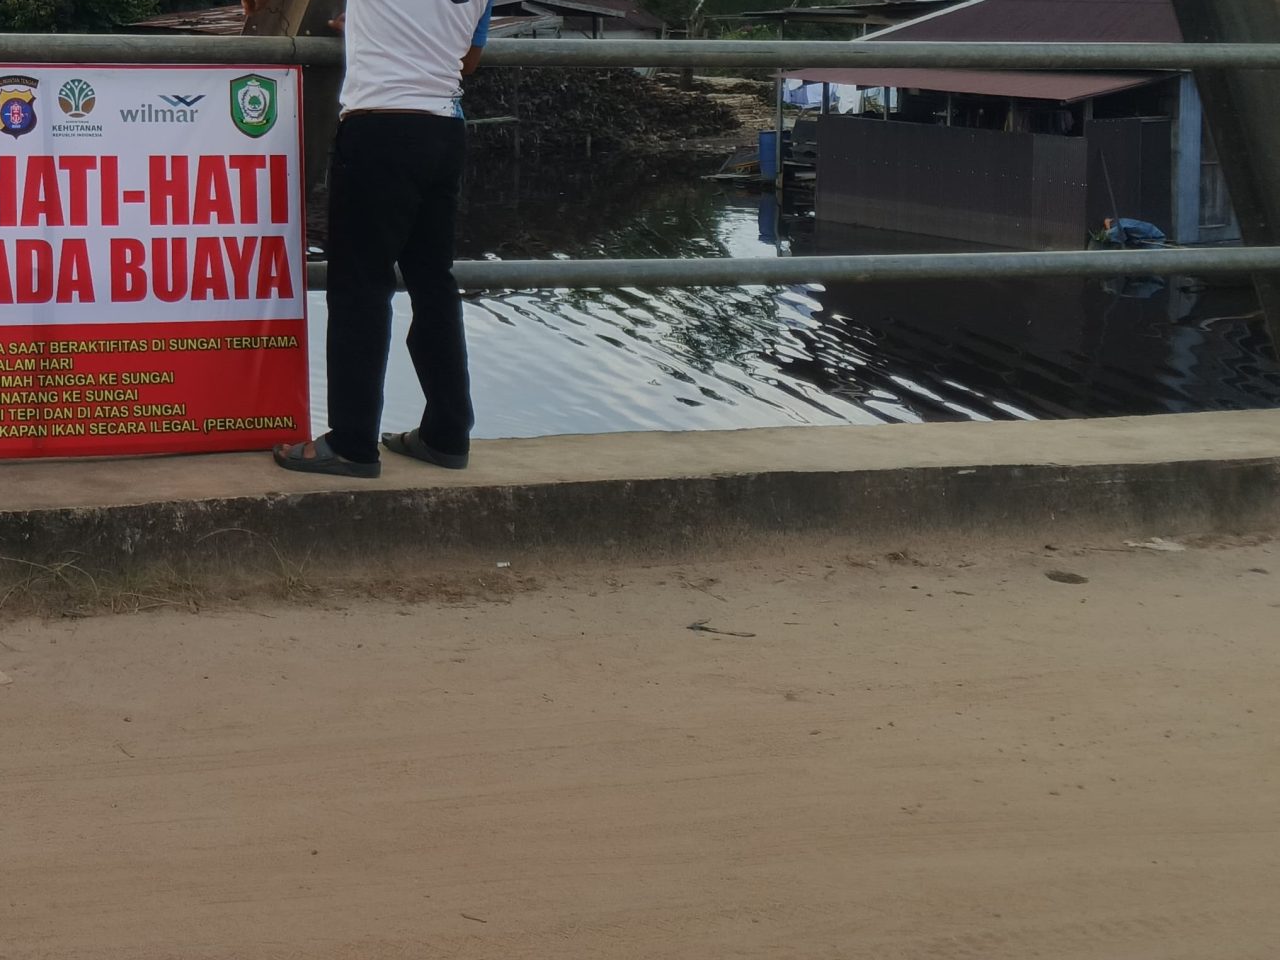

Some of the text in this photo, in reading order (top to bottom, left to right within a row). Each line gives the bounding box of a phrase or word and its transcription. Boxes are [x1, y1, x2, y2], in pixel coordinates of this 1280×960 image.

[119, 103, 199, 123] wilmar
[52, 124, 103, 132] KEHUTANAN
[110, 236, 295, 303] BUAYA
[8, 342, 46, 355] SAAT
[50, 339, 148, 354] BERAKTIFITAS
[152, 339, 165, 351] DI
[169, 338, 221, 351] SUNGAI
[224, 336, 297, 349] TERUTAMA
[40, 357, 73, 370] HARI
[37, 373, 96, 387] TANGGA
[99, 373, 118, 385] KE
[121, 371, 174, 385] SUNGAI
[62, 390, 81, 402] KE
[85, 389, 138, 402] SUNGAI
[8, 408, 40, 420] TEPI
[44, 407, 73, 420] DAN
[77, 406, 91, 418] DI
[94, 405, 129, 418] ATAS
[133, 404, 185, 417] SUNGAI
[52, 423, 85, 436] IKAN
[89, 421, 147, 435] SECARA
[150, 420, 198, 433] ILEGAL
[203, 416, 297, 434] (PERACUNAN,
